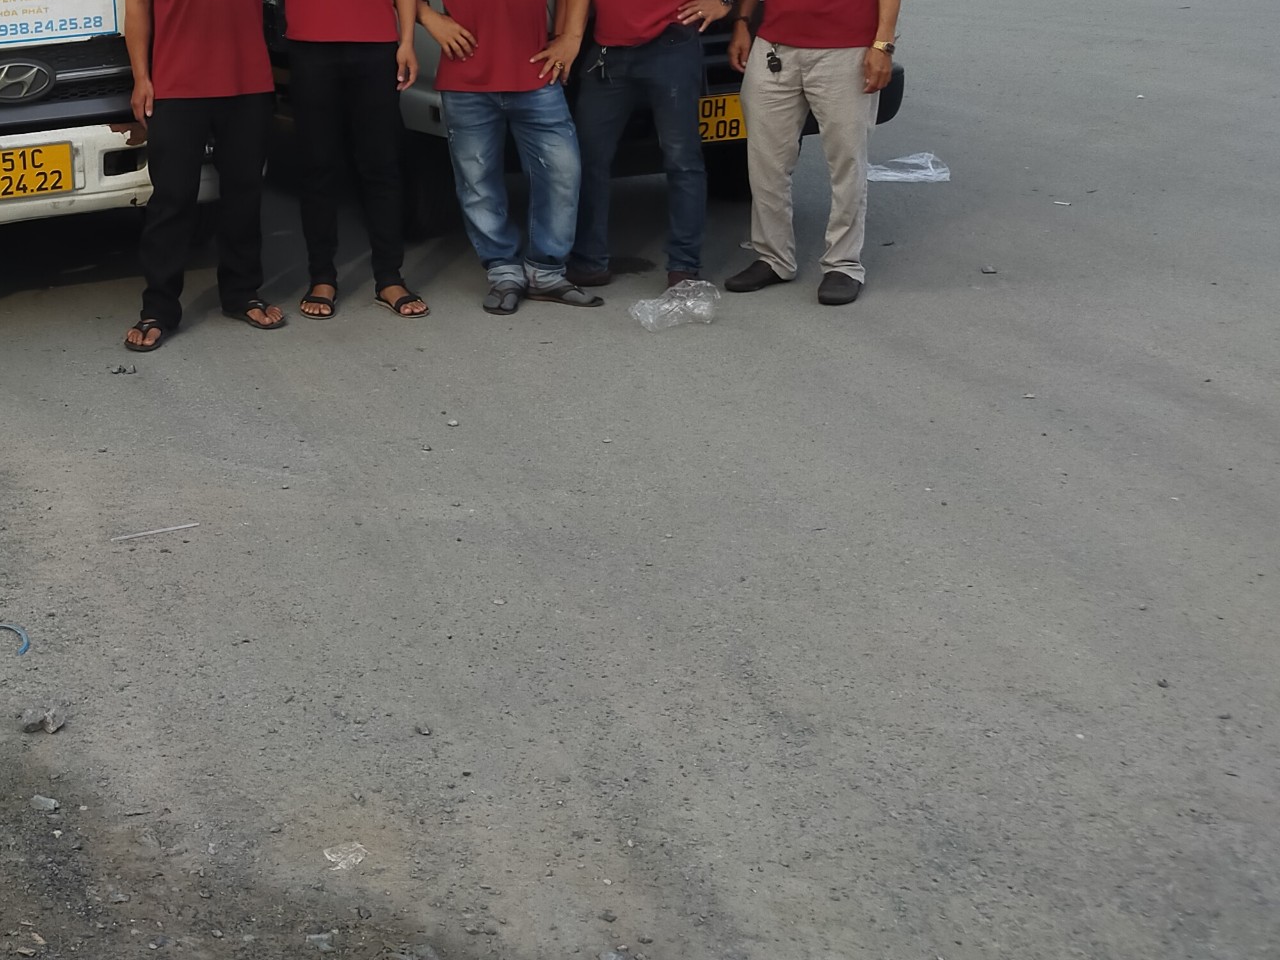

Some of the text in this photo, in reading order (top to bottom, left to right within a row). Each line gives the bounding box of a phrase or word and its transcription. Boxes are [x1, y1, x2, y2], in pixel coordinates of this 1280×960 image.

[701, 98, 726, 118] 0H
[699, 119, 740, 140] 2.08
[1, 148, 44, 172] 51C
